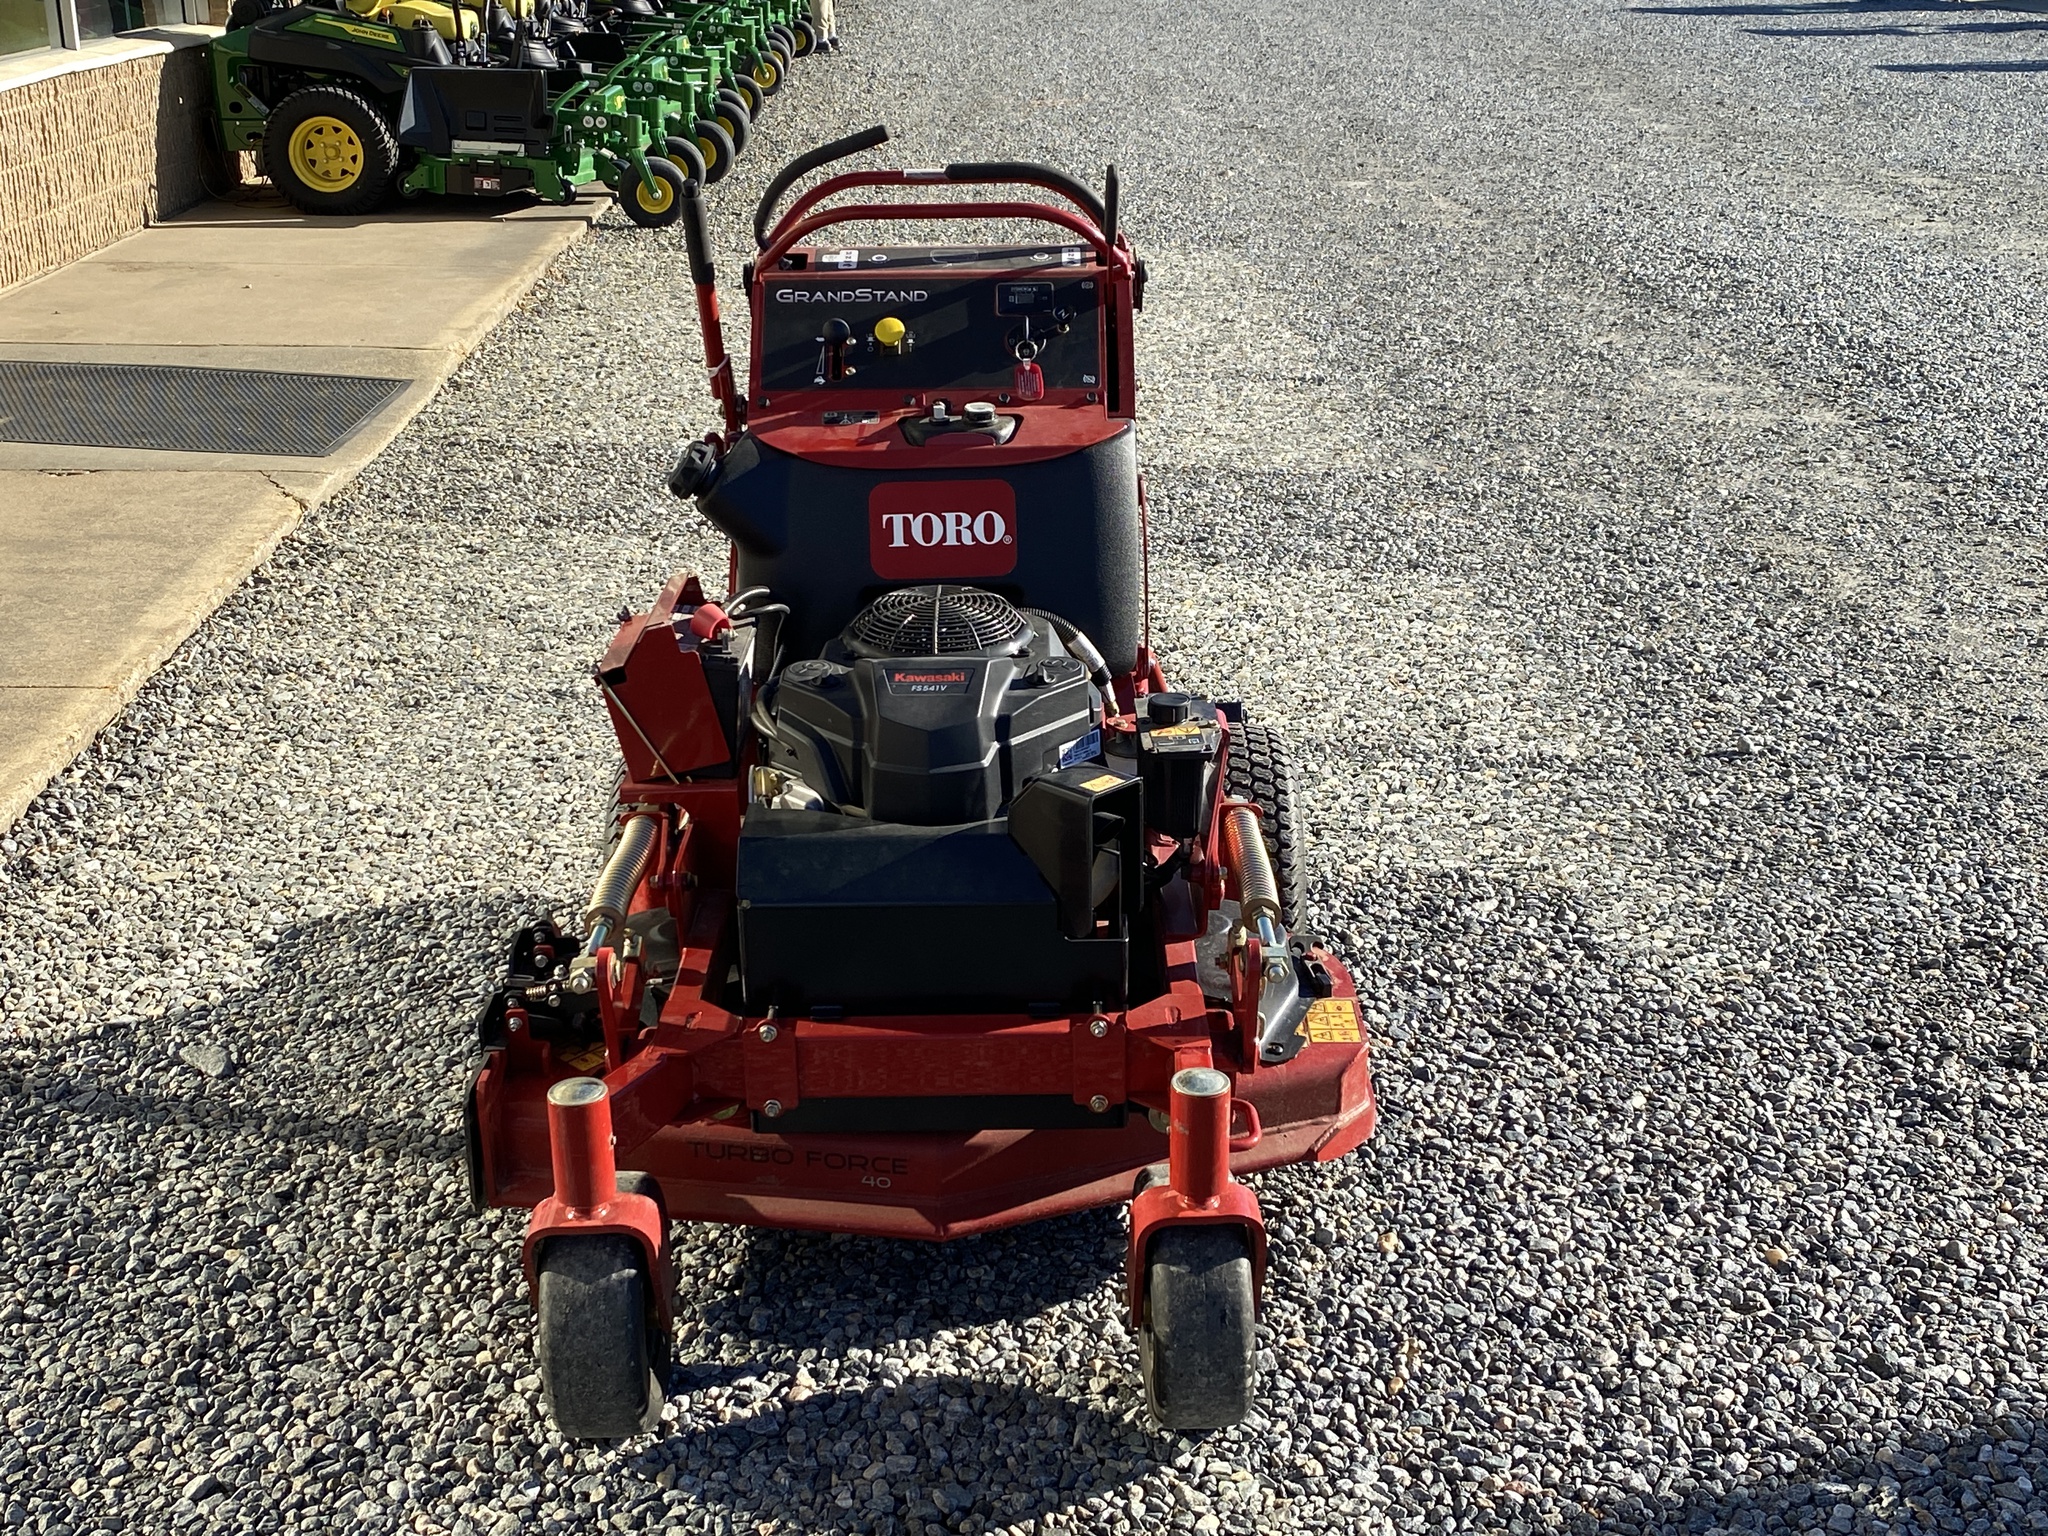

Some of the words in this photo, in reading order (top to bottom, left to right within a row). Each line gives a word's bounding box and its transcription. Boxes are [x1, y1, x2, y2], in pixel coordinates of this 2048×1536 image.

[351, 27, 368, 35] JOHN
[882, 510, 1007, 548] TORO
[894, 671, 965, 682] Kawasaki
[911, 684, 948, 692] FS541V
[688, 1141, 794, 1166] TURBO
[806, 1150, 909, 1175] FORCE
[861, 1175, 892, 1189] 40
